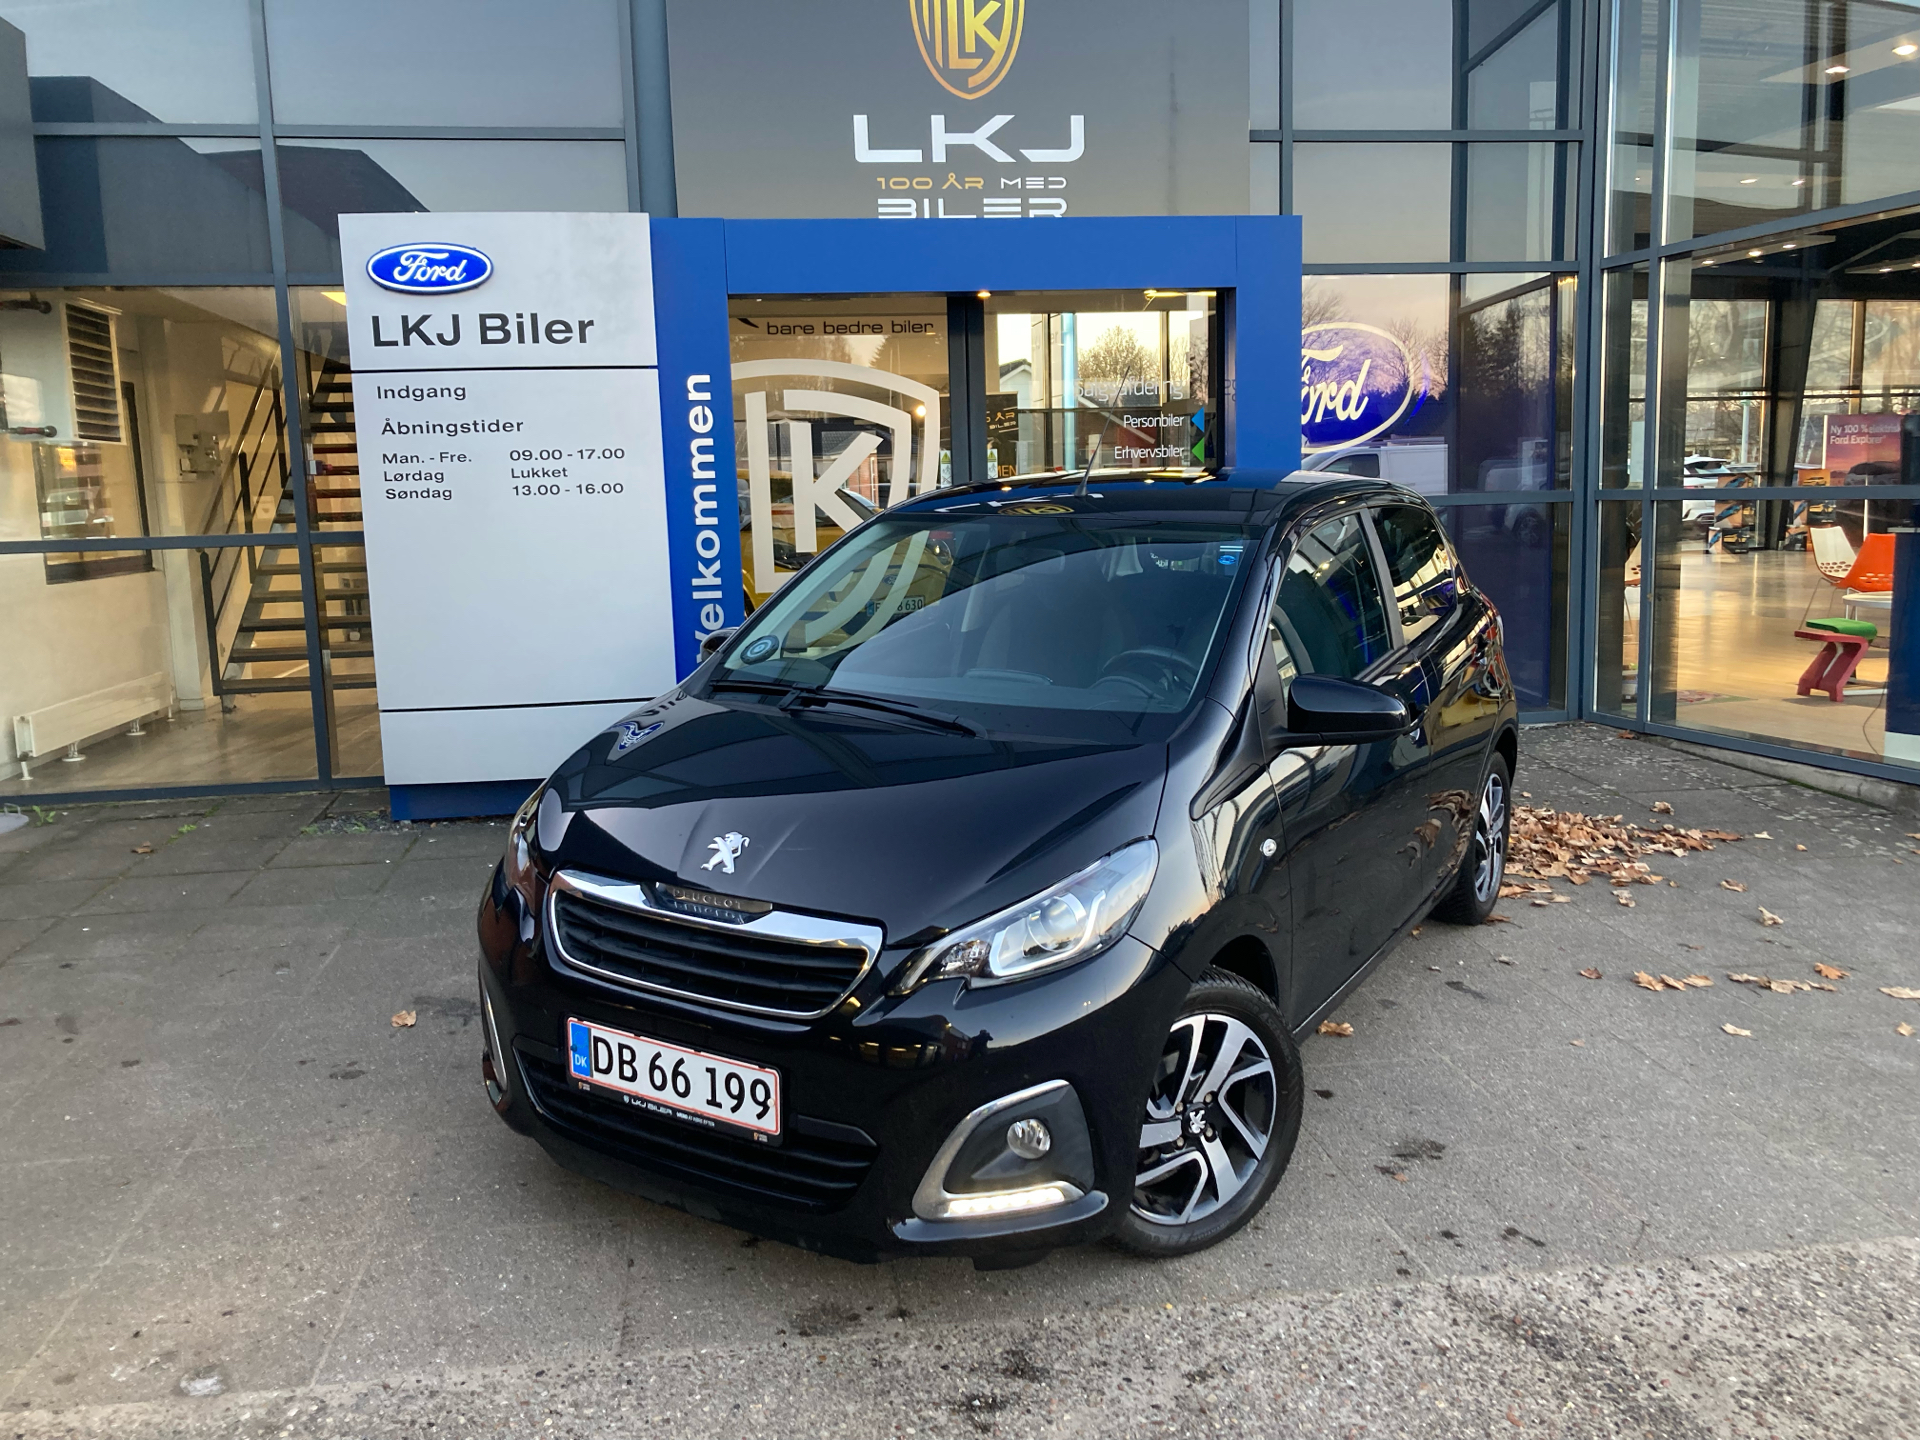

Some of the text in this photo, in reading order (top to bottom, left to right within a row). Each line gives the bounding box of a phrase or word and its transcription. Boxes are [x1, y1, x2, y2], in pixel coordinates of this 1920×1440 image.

[853, 114, 1085, 163] LKJ
[876, 172, 1067, 190] 100 ÅR MED
[877, 197, 1068, 219] BILER
[393, 250, 468, 282] Ford
[371, 312, 595, 347] LKJ Biler
[766, 319, 934, 336] bare bedre biler
[376, 385, 467, 402] Indgang
[381, 417, 524, 437] Åbningstider
[1123, 413, 1185, 429] Personbiler
[1830, 425, 1842, 436] Ny
[1844, 424, 1858, 433] 100
[1830, 435, 1850, 444] Ford
[382, 452, 425, 465] Man.
[439, 452, 472, 463] Fre.
[509, 449, 563, 462] 09.00
[576, 448, 625, 461] 17.00
[1114, 445, 1184, 460] Erhvervsbiler
[384, 467, 568, 484] Lørdag Lukket
[385, 487, 452, 501] Søndag
[512, 484, 561, 496] 13.00
[575, 482, 624, 495] 16.00
[574, 1053, 588, 1069] DK
[593, 1035, 772, 1121] DB 66 199
